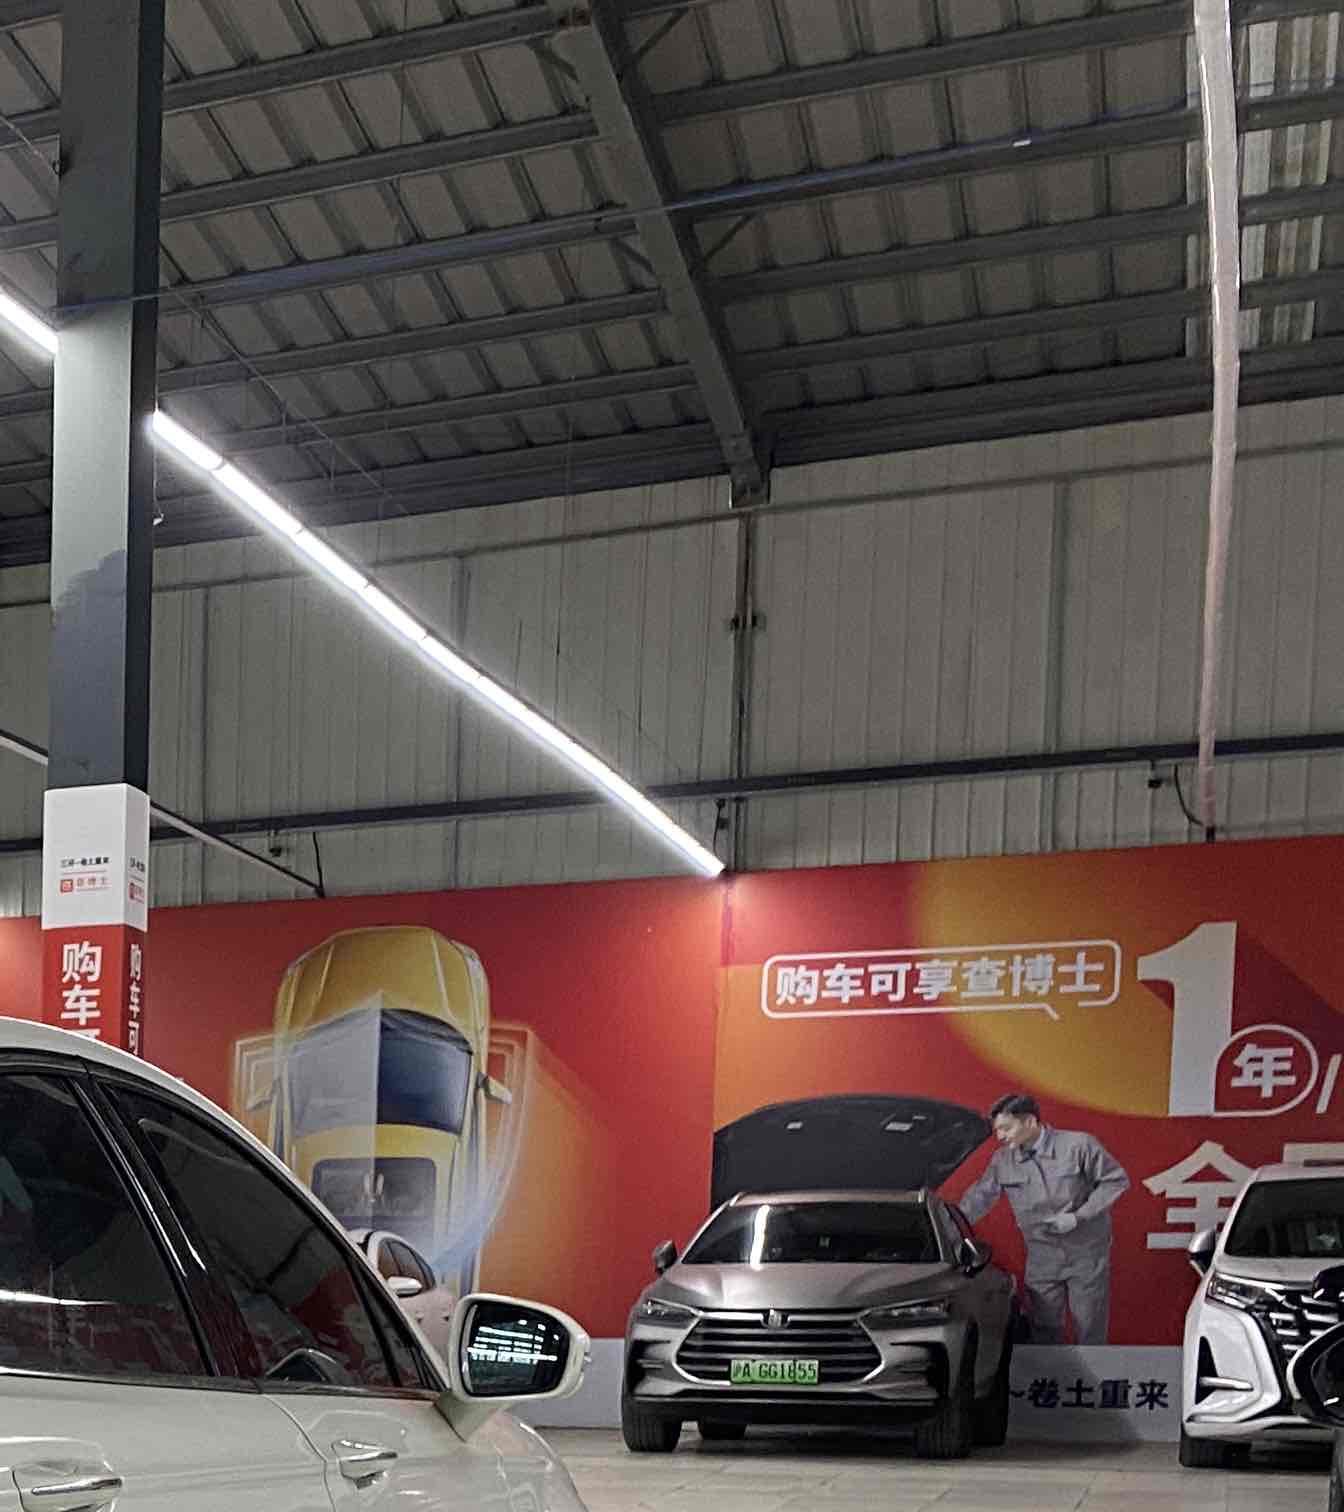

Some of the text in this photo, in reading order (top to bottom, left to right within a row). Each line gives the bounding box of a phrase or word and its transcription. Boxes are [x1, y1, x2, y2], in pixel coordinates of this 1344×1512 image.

[61, 941, 102, 1038] 购车
[129, 944, 142, 1055] 购车可
[776, 952, 1105, 1006] 购车可享查博士
